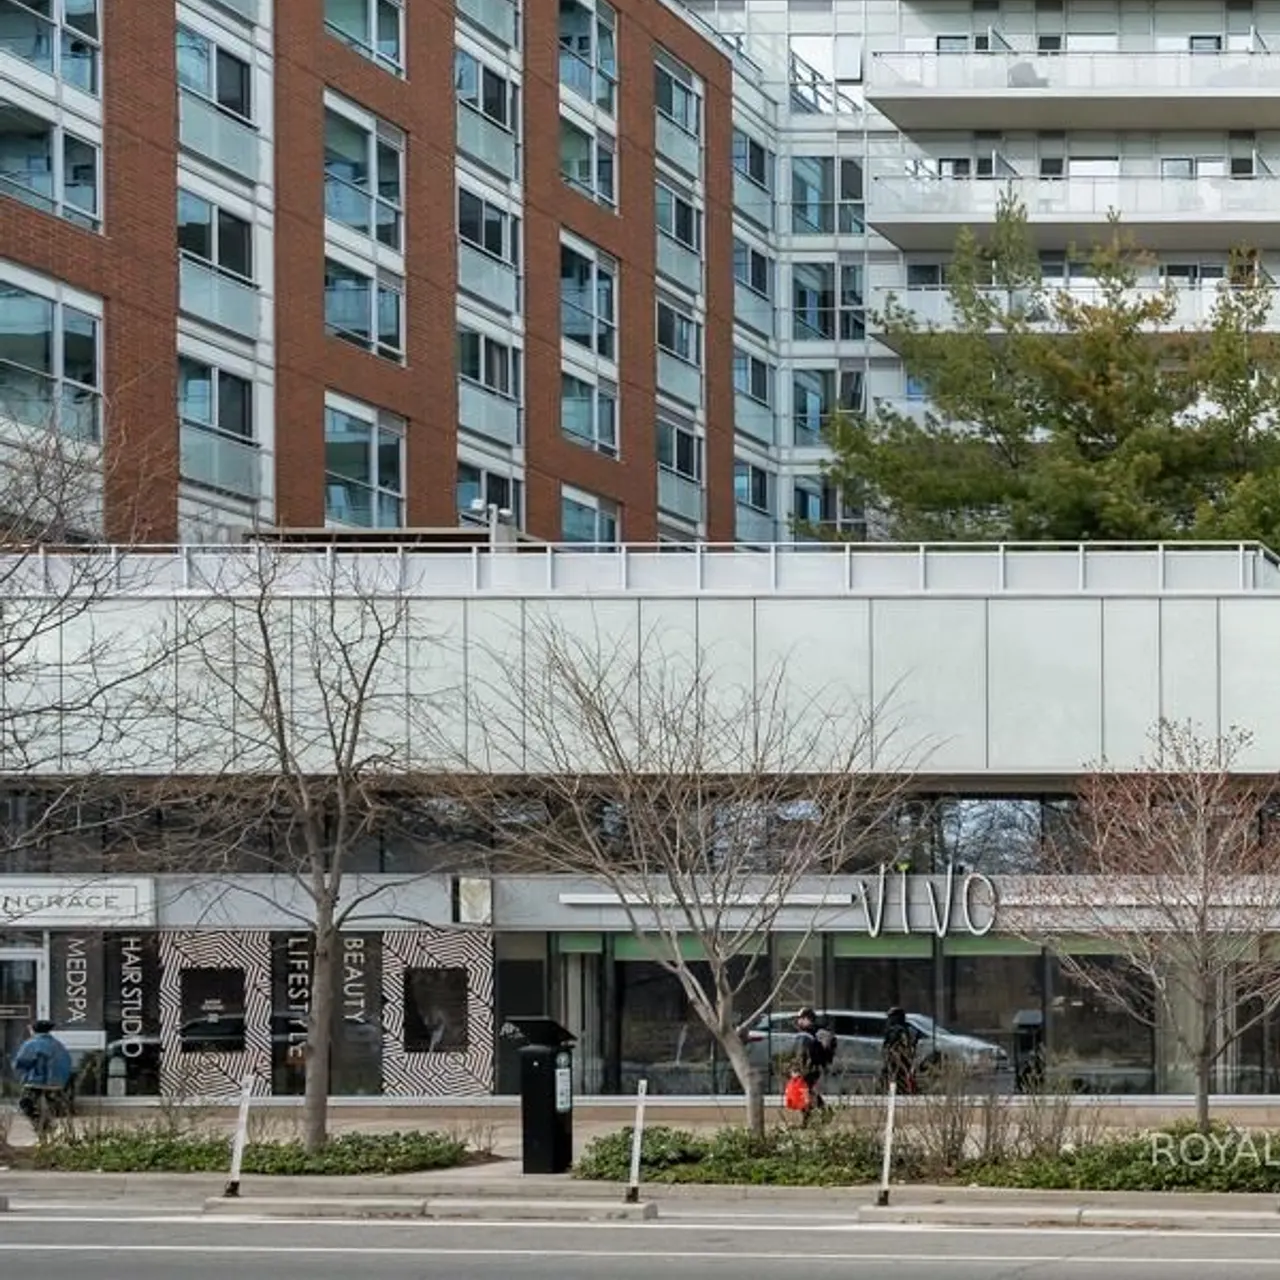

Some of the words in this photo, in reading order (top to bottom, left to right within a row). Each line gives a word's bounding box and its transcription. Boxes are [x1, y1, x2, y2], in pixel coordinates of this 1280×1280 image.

[858, 854, 996, 938] VIVO
[66, 938, 87, 1023] MEDSPA
[121, 937, 142, 983] HAIR
[343, 938, 365, 1024] BEAUTY
[121, 987, 142, 1057] STUDIO
